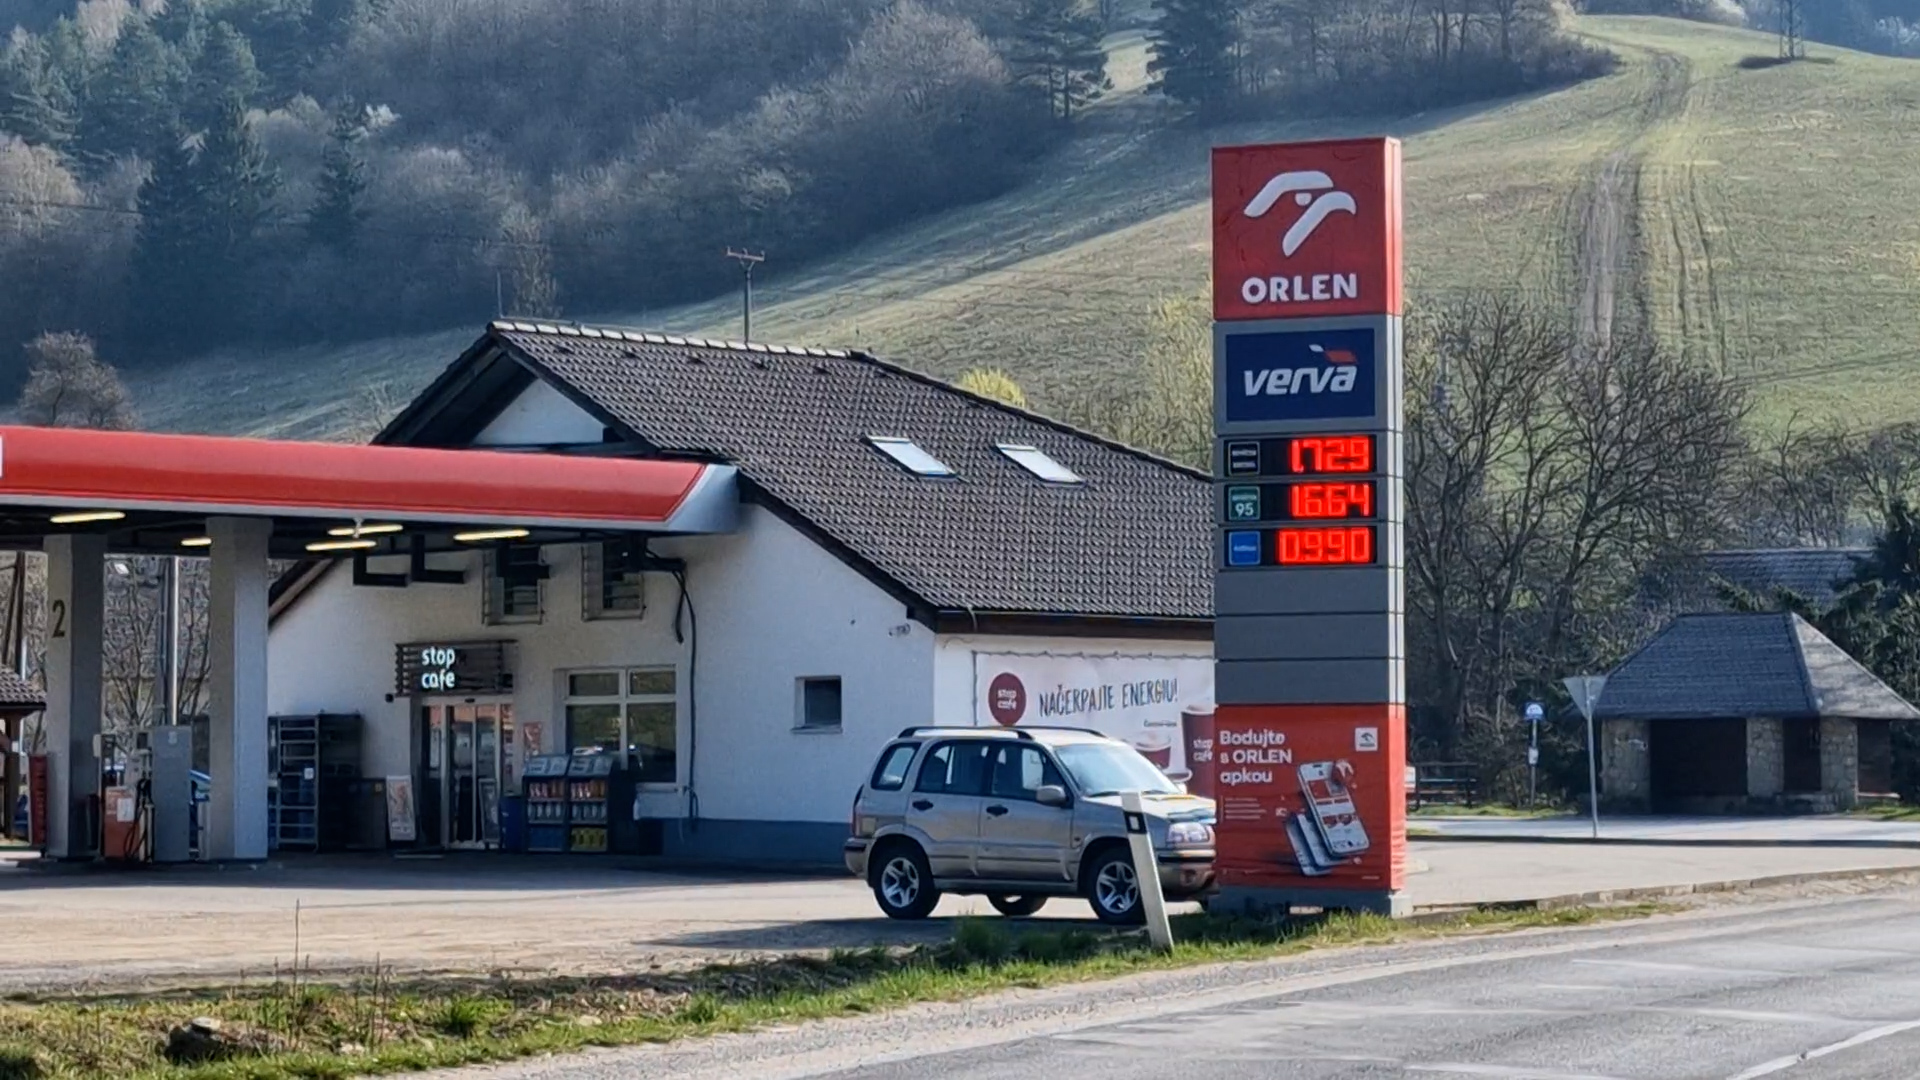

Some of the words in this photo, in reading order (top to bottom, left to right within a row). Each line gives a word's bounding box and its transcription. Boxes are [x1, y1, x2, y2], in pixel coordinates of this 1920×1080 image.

[1241, 273, 1358, 304] ORLEN
[1244, 366, 1357, 396] verva
[1235, 502, 1254, 516] 95
[52, 599, 66, 638] 2
[421, 646, 456, 669] stop
[421, 669, 456, 691] cafe
[1038, 684, 1115, 718] NAČERPAJTE
[1121, 678, 1178, 709] ENERGIU!
[1220, 728, 1285, 747] Bodujte
[1220, 753, 1229, 764] s
[1233, 748, 1292, 764] ORLEN
[1220, 767, 1273, 786] apkou
